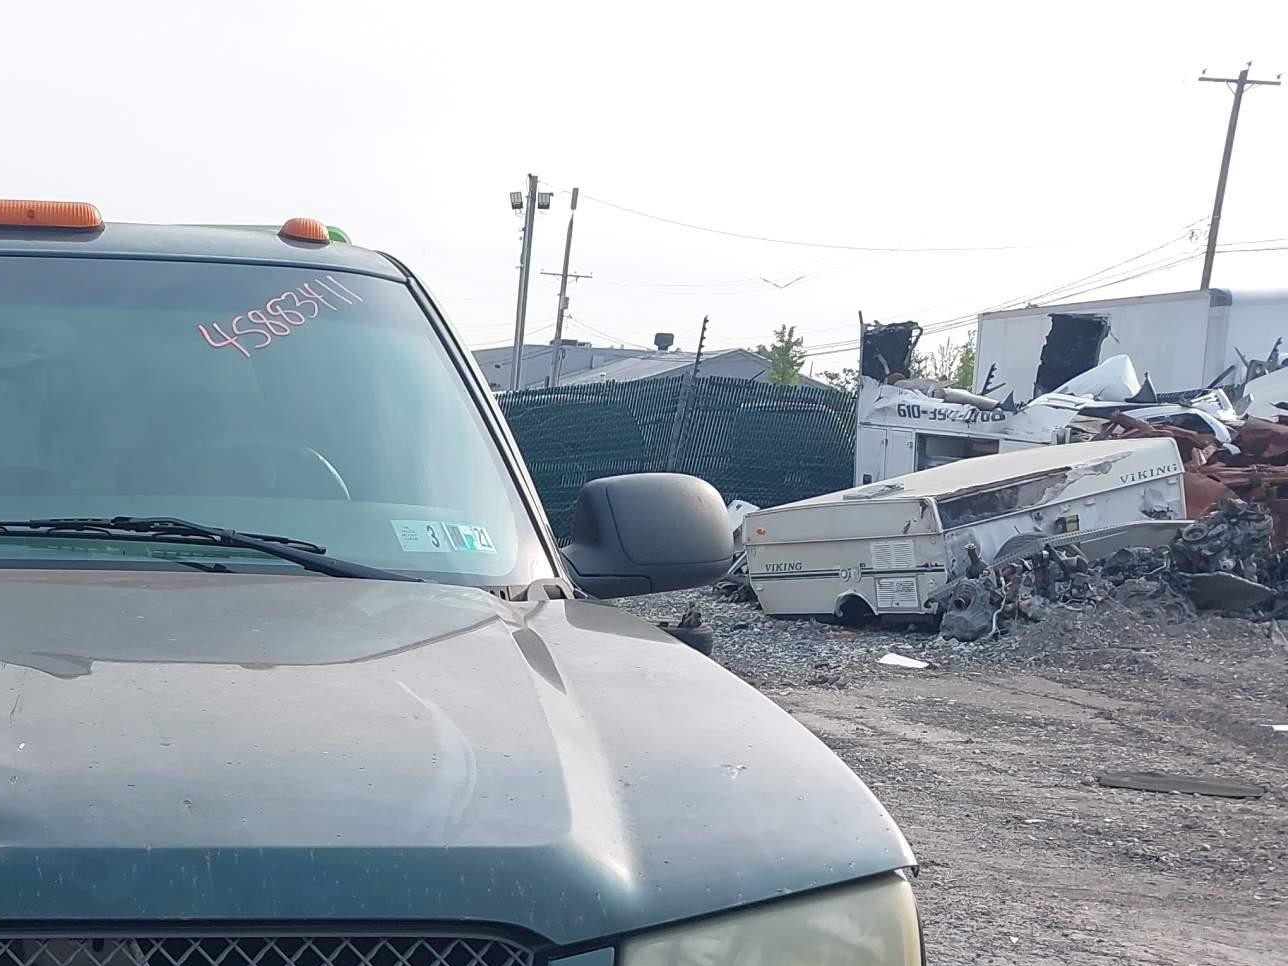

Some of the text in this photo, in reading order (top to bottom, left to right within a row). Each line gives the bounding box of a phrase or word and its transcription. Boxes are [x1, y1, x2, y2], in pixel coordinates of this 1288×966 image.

[198, 275, 364, 358] 45883411
[1119, 463, 1177, 484] VIKING
[426, 524, 441, 548] 3
[764, 562, 803, 572] VIKING
